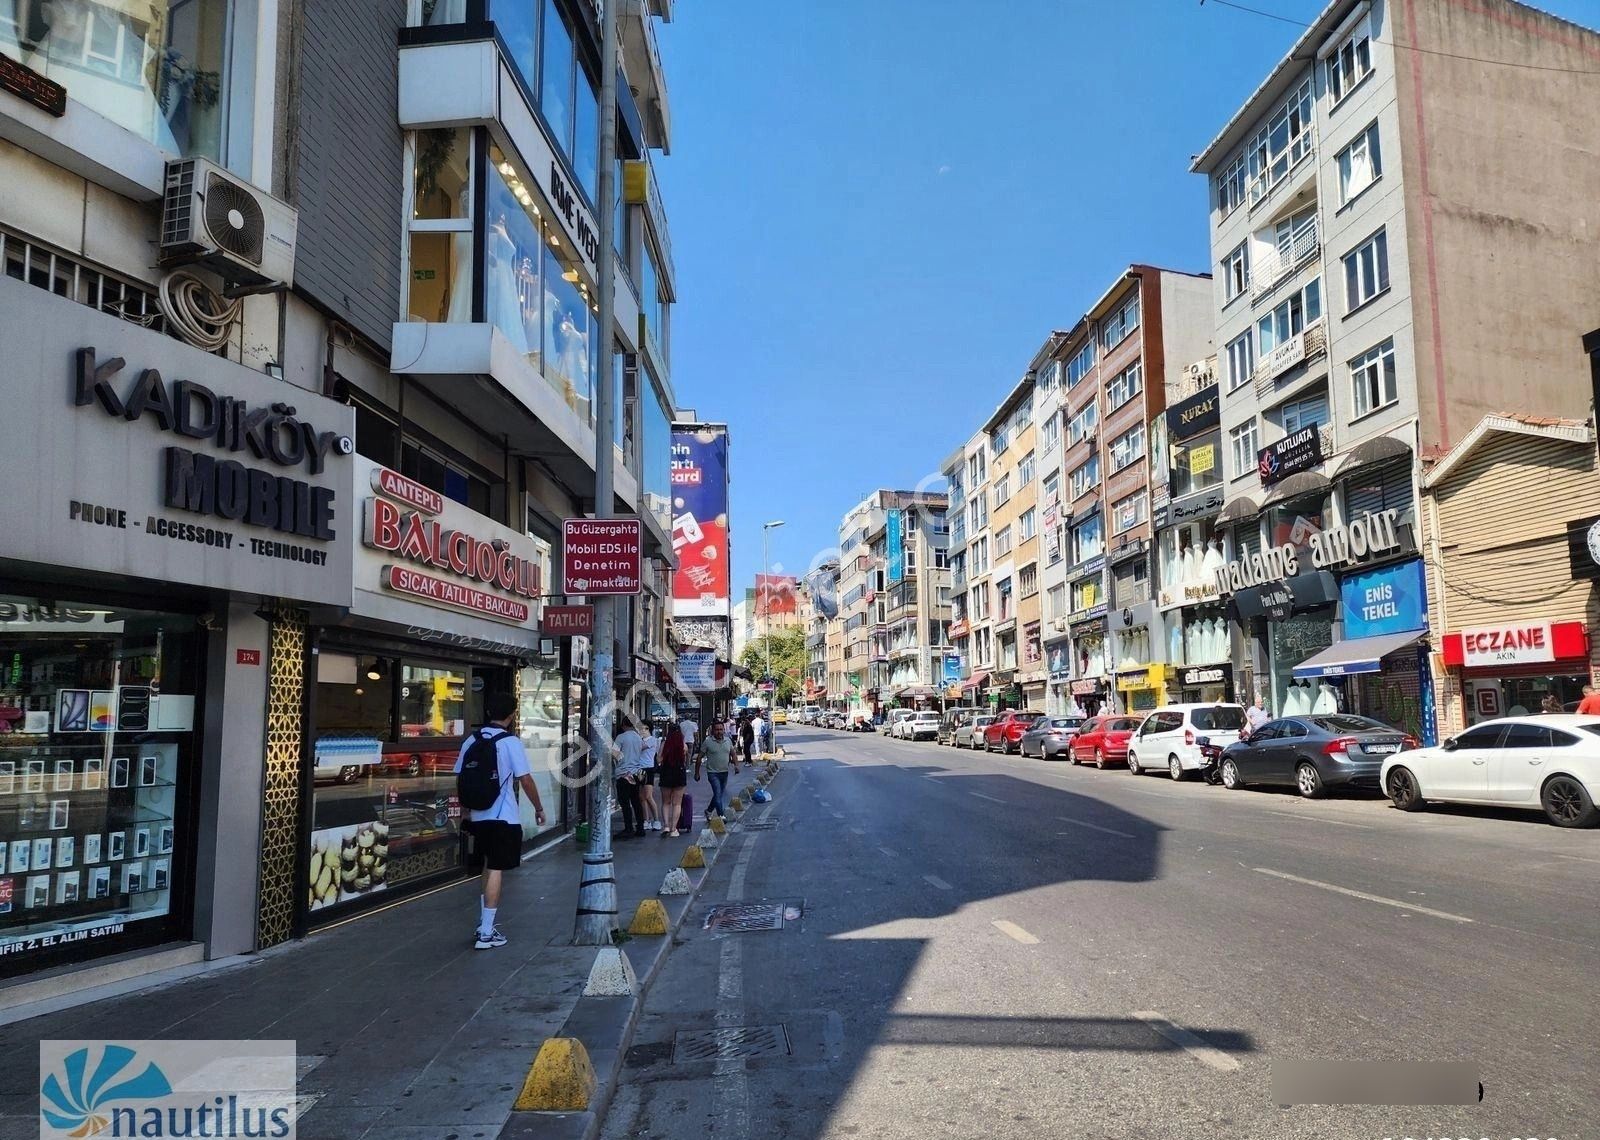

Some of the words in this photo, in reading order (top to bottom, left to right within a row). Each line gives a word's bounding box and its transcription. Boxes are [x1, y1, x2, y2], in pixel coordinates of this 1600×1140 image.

[1180, 396, 1218, 424] NURAY
[1276, 428, 1313, 455] KUTLUATA
[164, 446, 336, 541] MOBILE
[69, 500, 127, 529] PHONE
[146, 516, 233, 550] ACCESSORY
[250, 537, 328, 567] TECHNOLOGY
[567, 524, 580, 535] Bu
[581, 524, 638, 537] Güzergahta
[373, 496, 541, 598] BALCIOĞLU
[566, 543, 597, 554] Mobil
[599, 543, 622, 554] EDS
[623, 543, 638, 554] ile
[1213, 542, 1299, 596] madame
[1308, 508, 1401, 569] amour
[574, 560, 631, 570] Denetim
[400, 570, 437, 596] SICAK
[440, 582, 468, 604] TATLI
[470, 590, 484, 608] VE
[485, 595, 525, 619] BAKLAVA
[1365, 582, 1393, 604] ENİS
[548, 613, 590, 627] TATLICI
[1362, 601, 1400, 621] TEKEL
[1465, 627, 1545, 653] ECZANE
[1496, 652, 1516, 660] AKIN
[27, 939, 39, 950] 2.
[42, 936, 57, 947] EL
[60, 929, 89, 944] ALIM
[90, 923, 125, 938] SATIM
